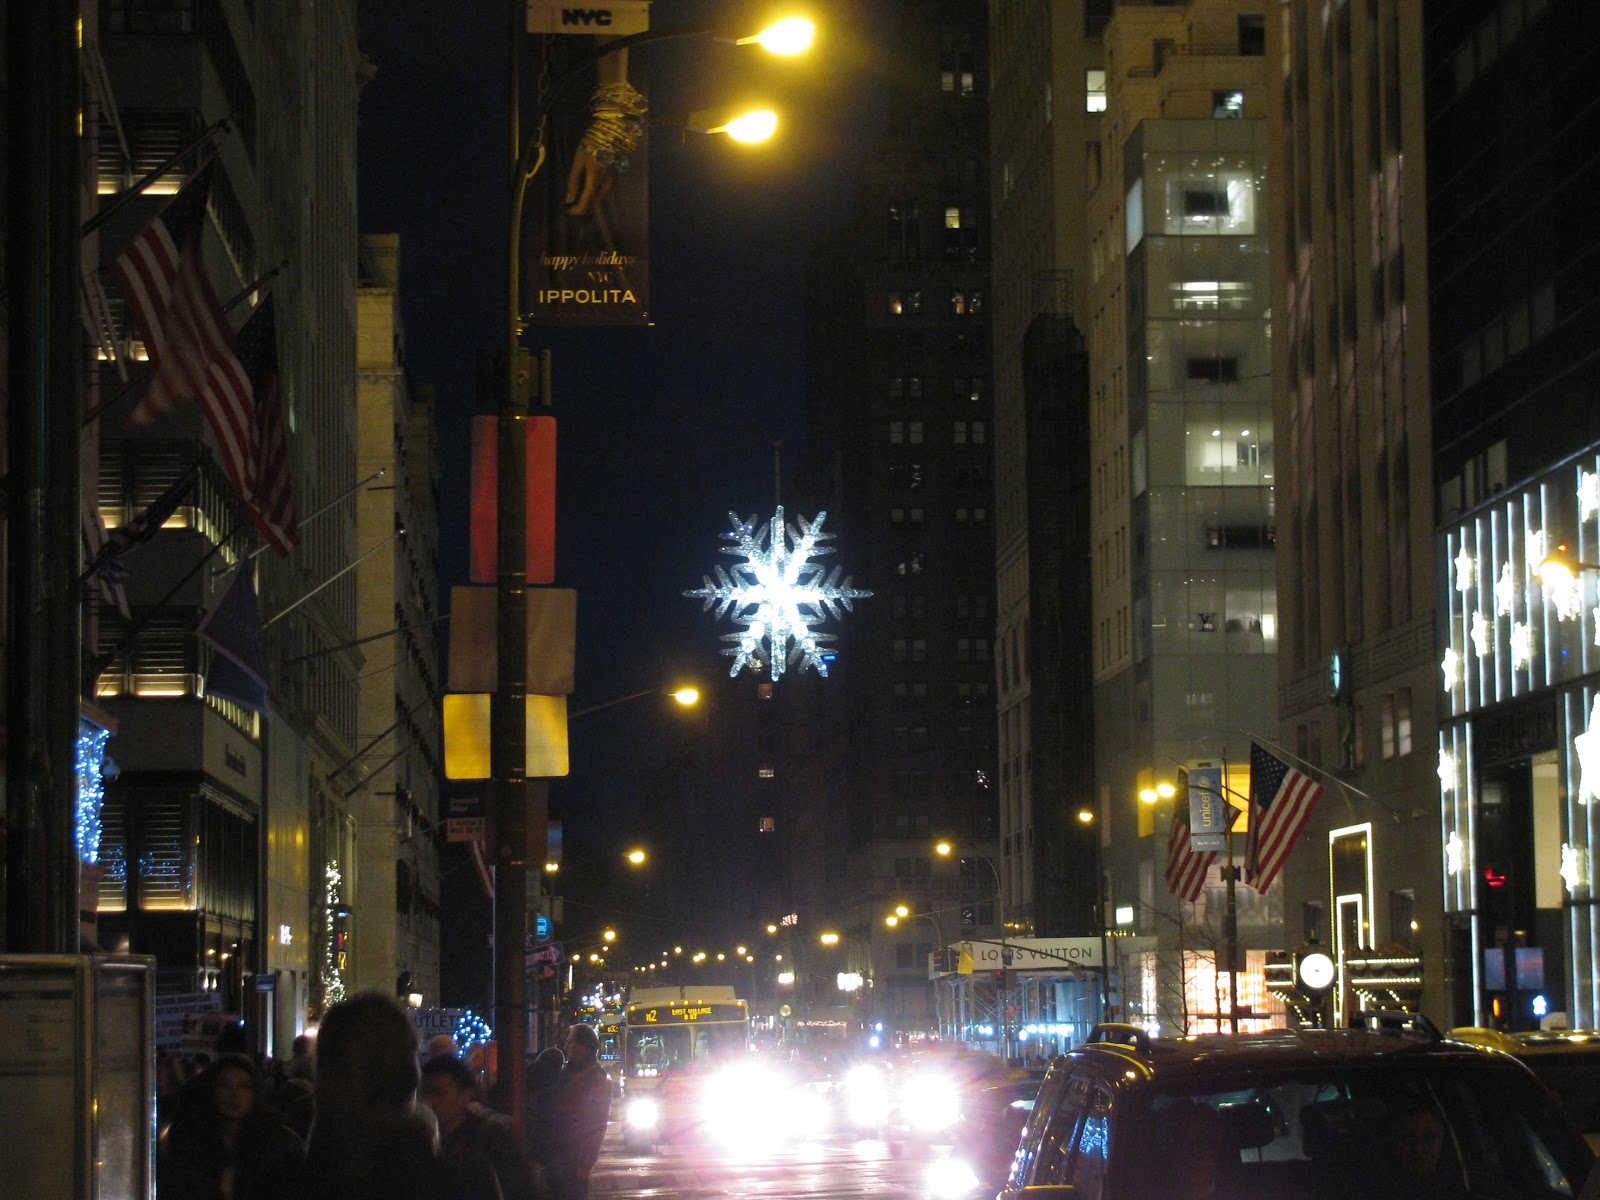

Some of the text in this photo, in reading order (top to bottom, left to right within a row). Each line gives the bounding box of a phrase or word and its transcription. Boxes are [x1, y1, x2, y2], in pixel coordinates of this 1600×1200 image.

[562, 9, 612, 26] NYC
[540, 250, 637, 270] happy holidays
[539, 289, 637, 304] IPPOLITA
[1198, 791, 1211, 827] unicef
[981, 947, 1092, 960] LOIS VUITTON
[672, 1008, 686, 1016] EAST
[687, 1007, 712, 1015] VILLAGE
